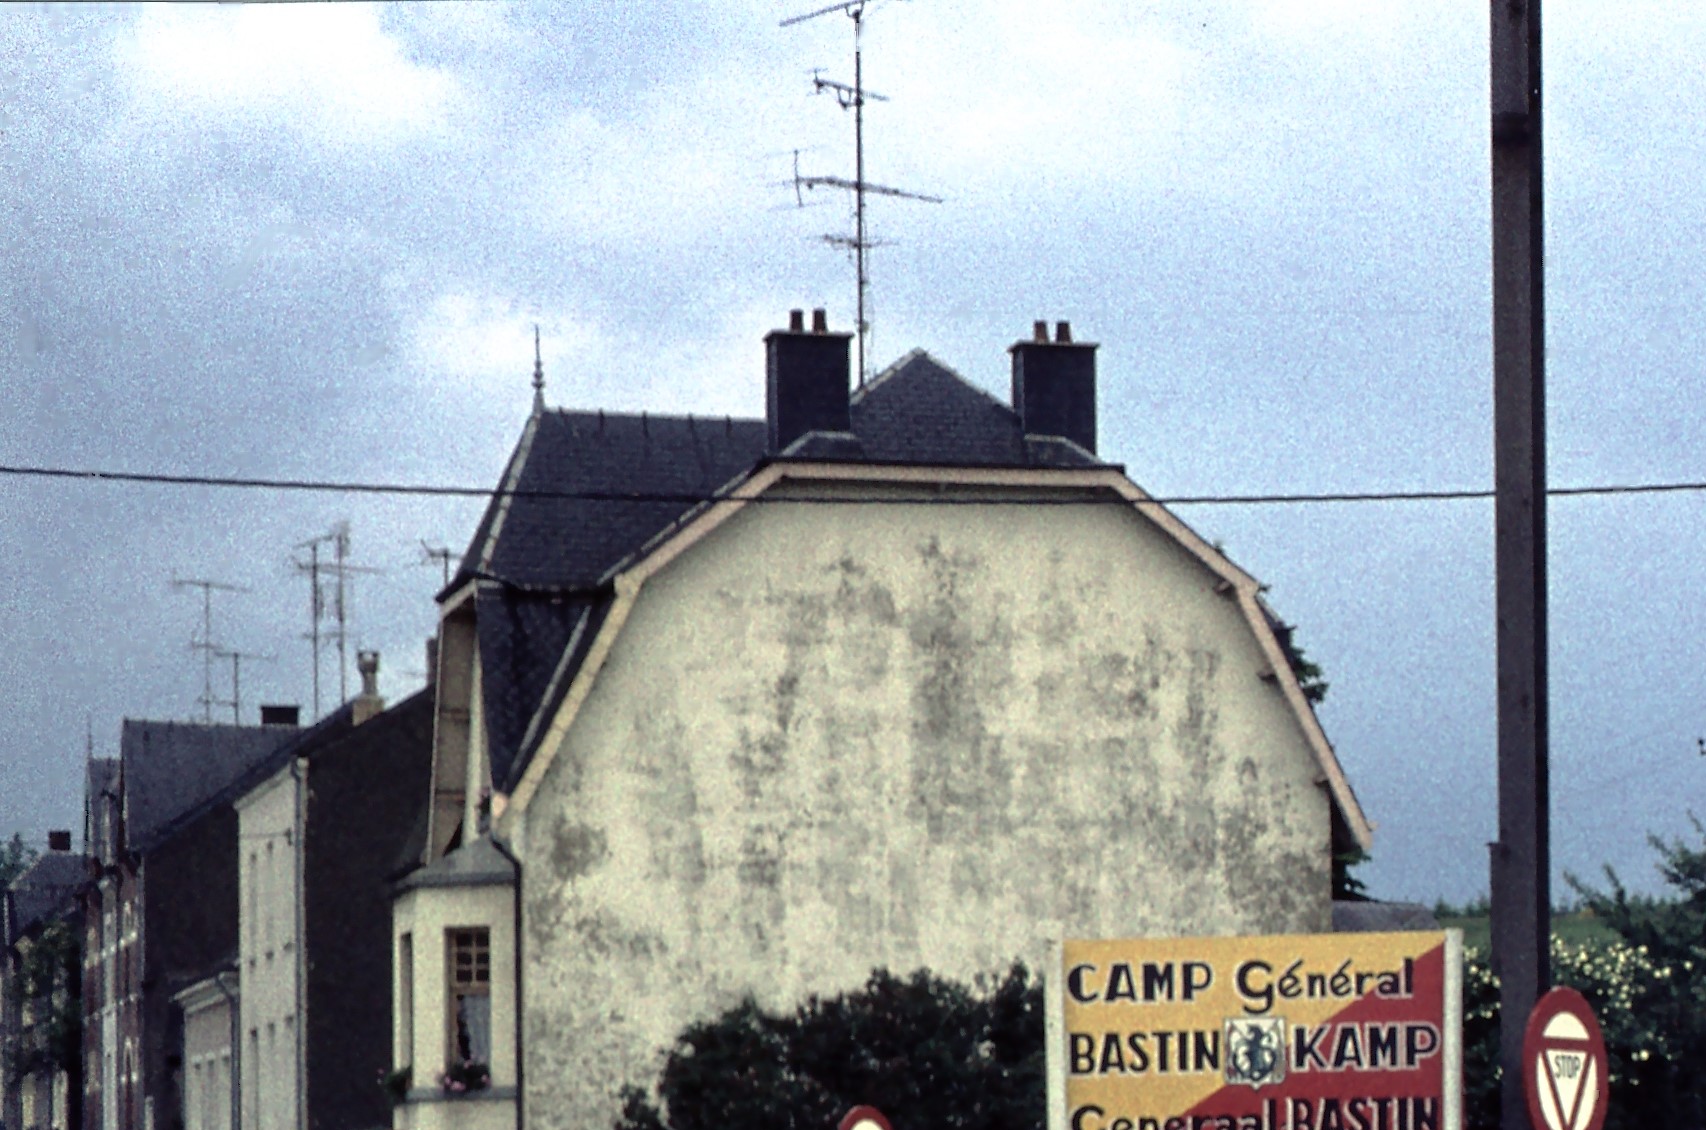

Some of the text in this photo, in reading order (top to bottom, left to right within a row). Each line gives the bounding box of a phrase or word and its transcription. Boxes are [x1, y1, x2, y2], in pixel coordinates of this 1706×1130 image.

[1067, 956, 1415, 1015] CAMP Général
[1068, 1024, 1439, 1075] BASTIN KAMP
[1554, 1054, 1581, 1079] STOP
